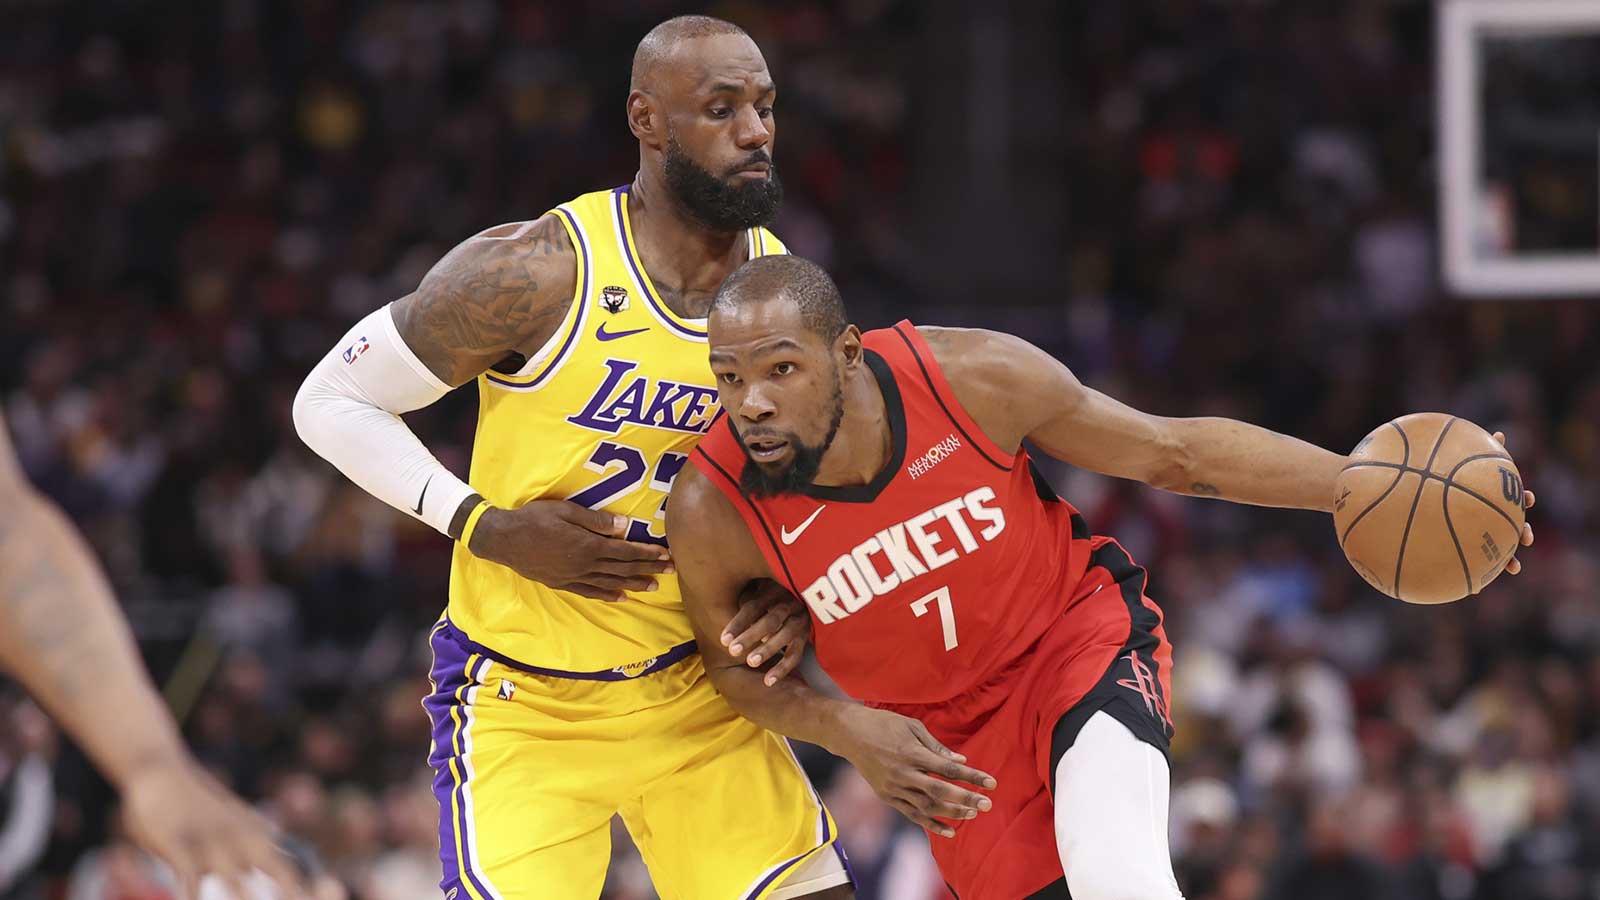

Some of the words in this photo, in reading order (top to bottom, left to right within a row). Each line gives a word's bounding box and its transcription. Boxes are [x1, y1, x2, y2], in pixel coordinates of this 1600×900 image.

[907, 433, 959, 474] MEMORIAL
[909, 438, 962, 480] HERMANN
[800, 485, 1006, 625] ROCKETS
[909, 584, 959, 652] 7
